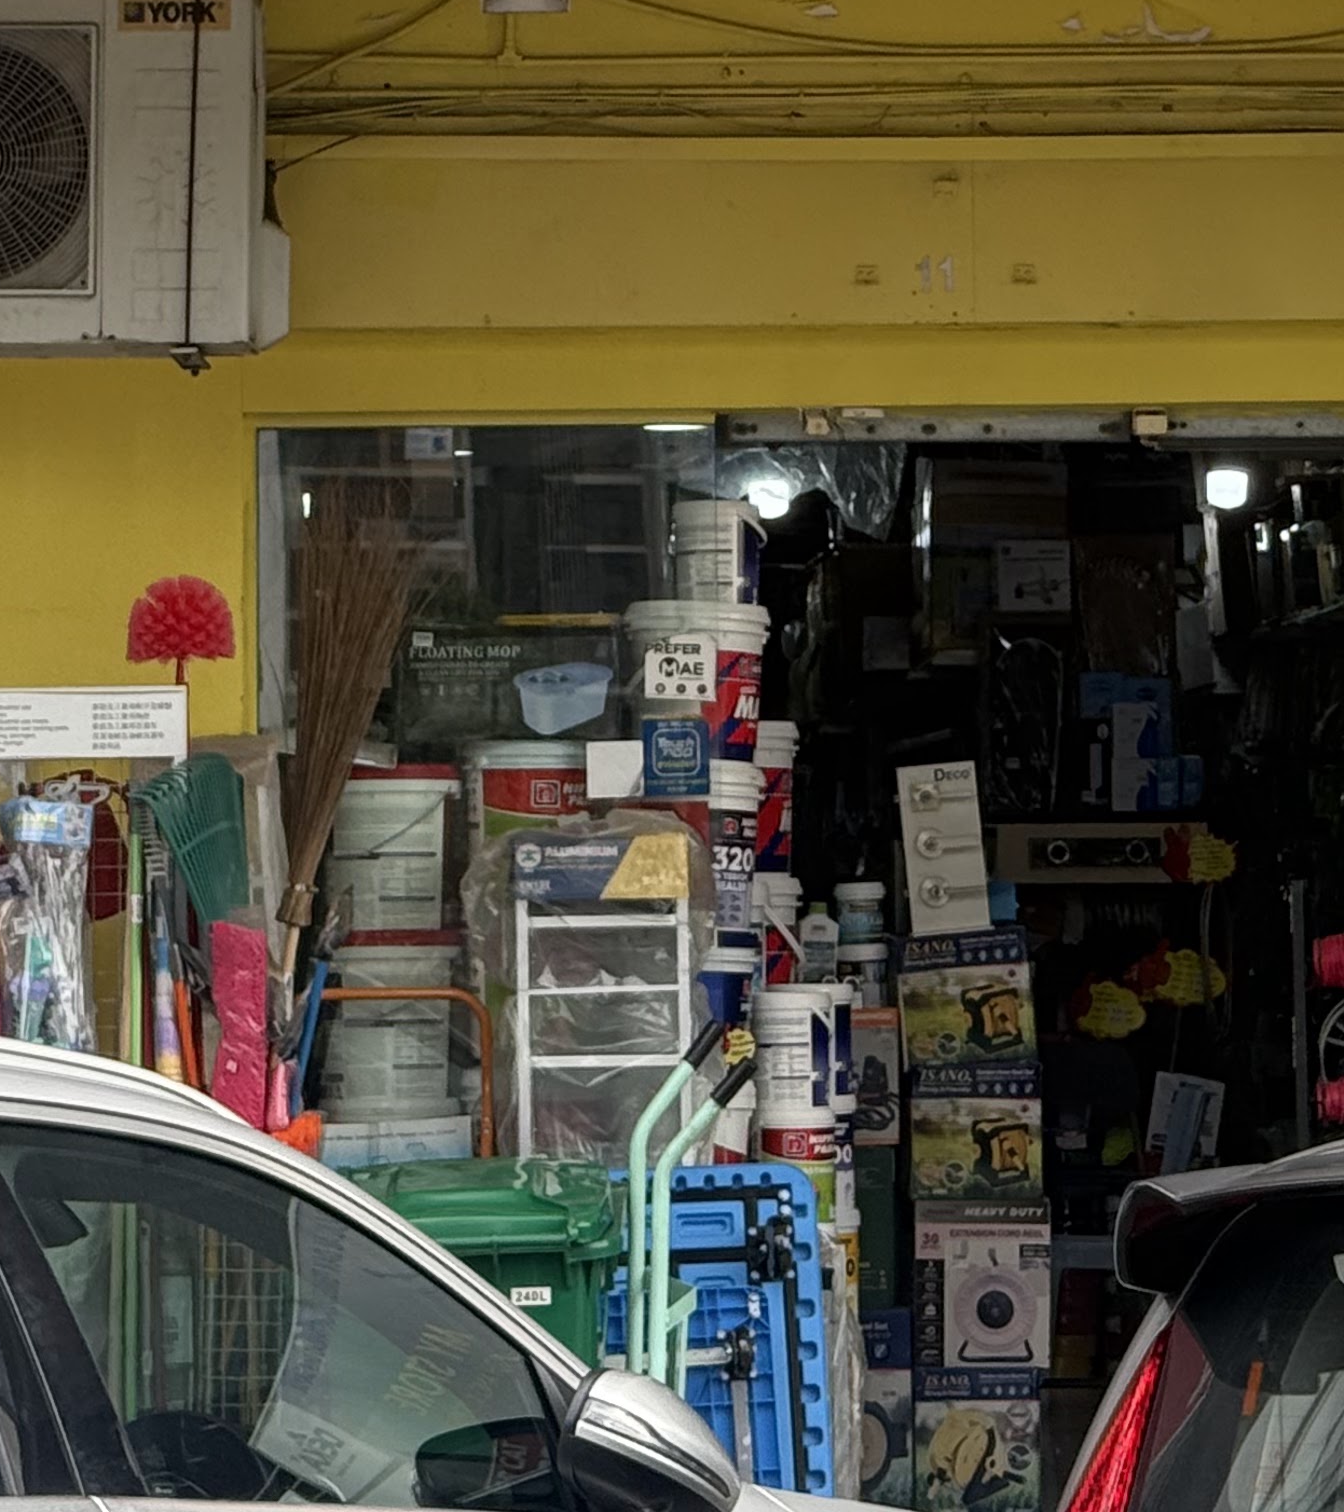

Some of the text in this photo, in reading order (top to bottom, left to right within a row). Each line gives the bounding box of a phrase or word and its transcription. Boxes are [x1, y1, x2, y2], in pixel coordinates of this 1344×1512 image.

[146, 0, 217, 23] YORK
[408, 644, 521, 659] FLOATING MOP
[645, 643, 702, 656] PREFER
[711, 844, 755, 872] 320
[963, 1206, 1044, 1218] HEAVY DUTY
